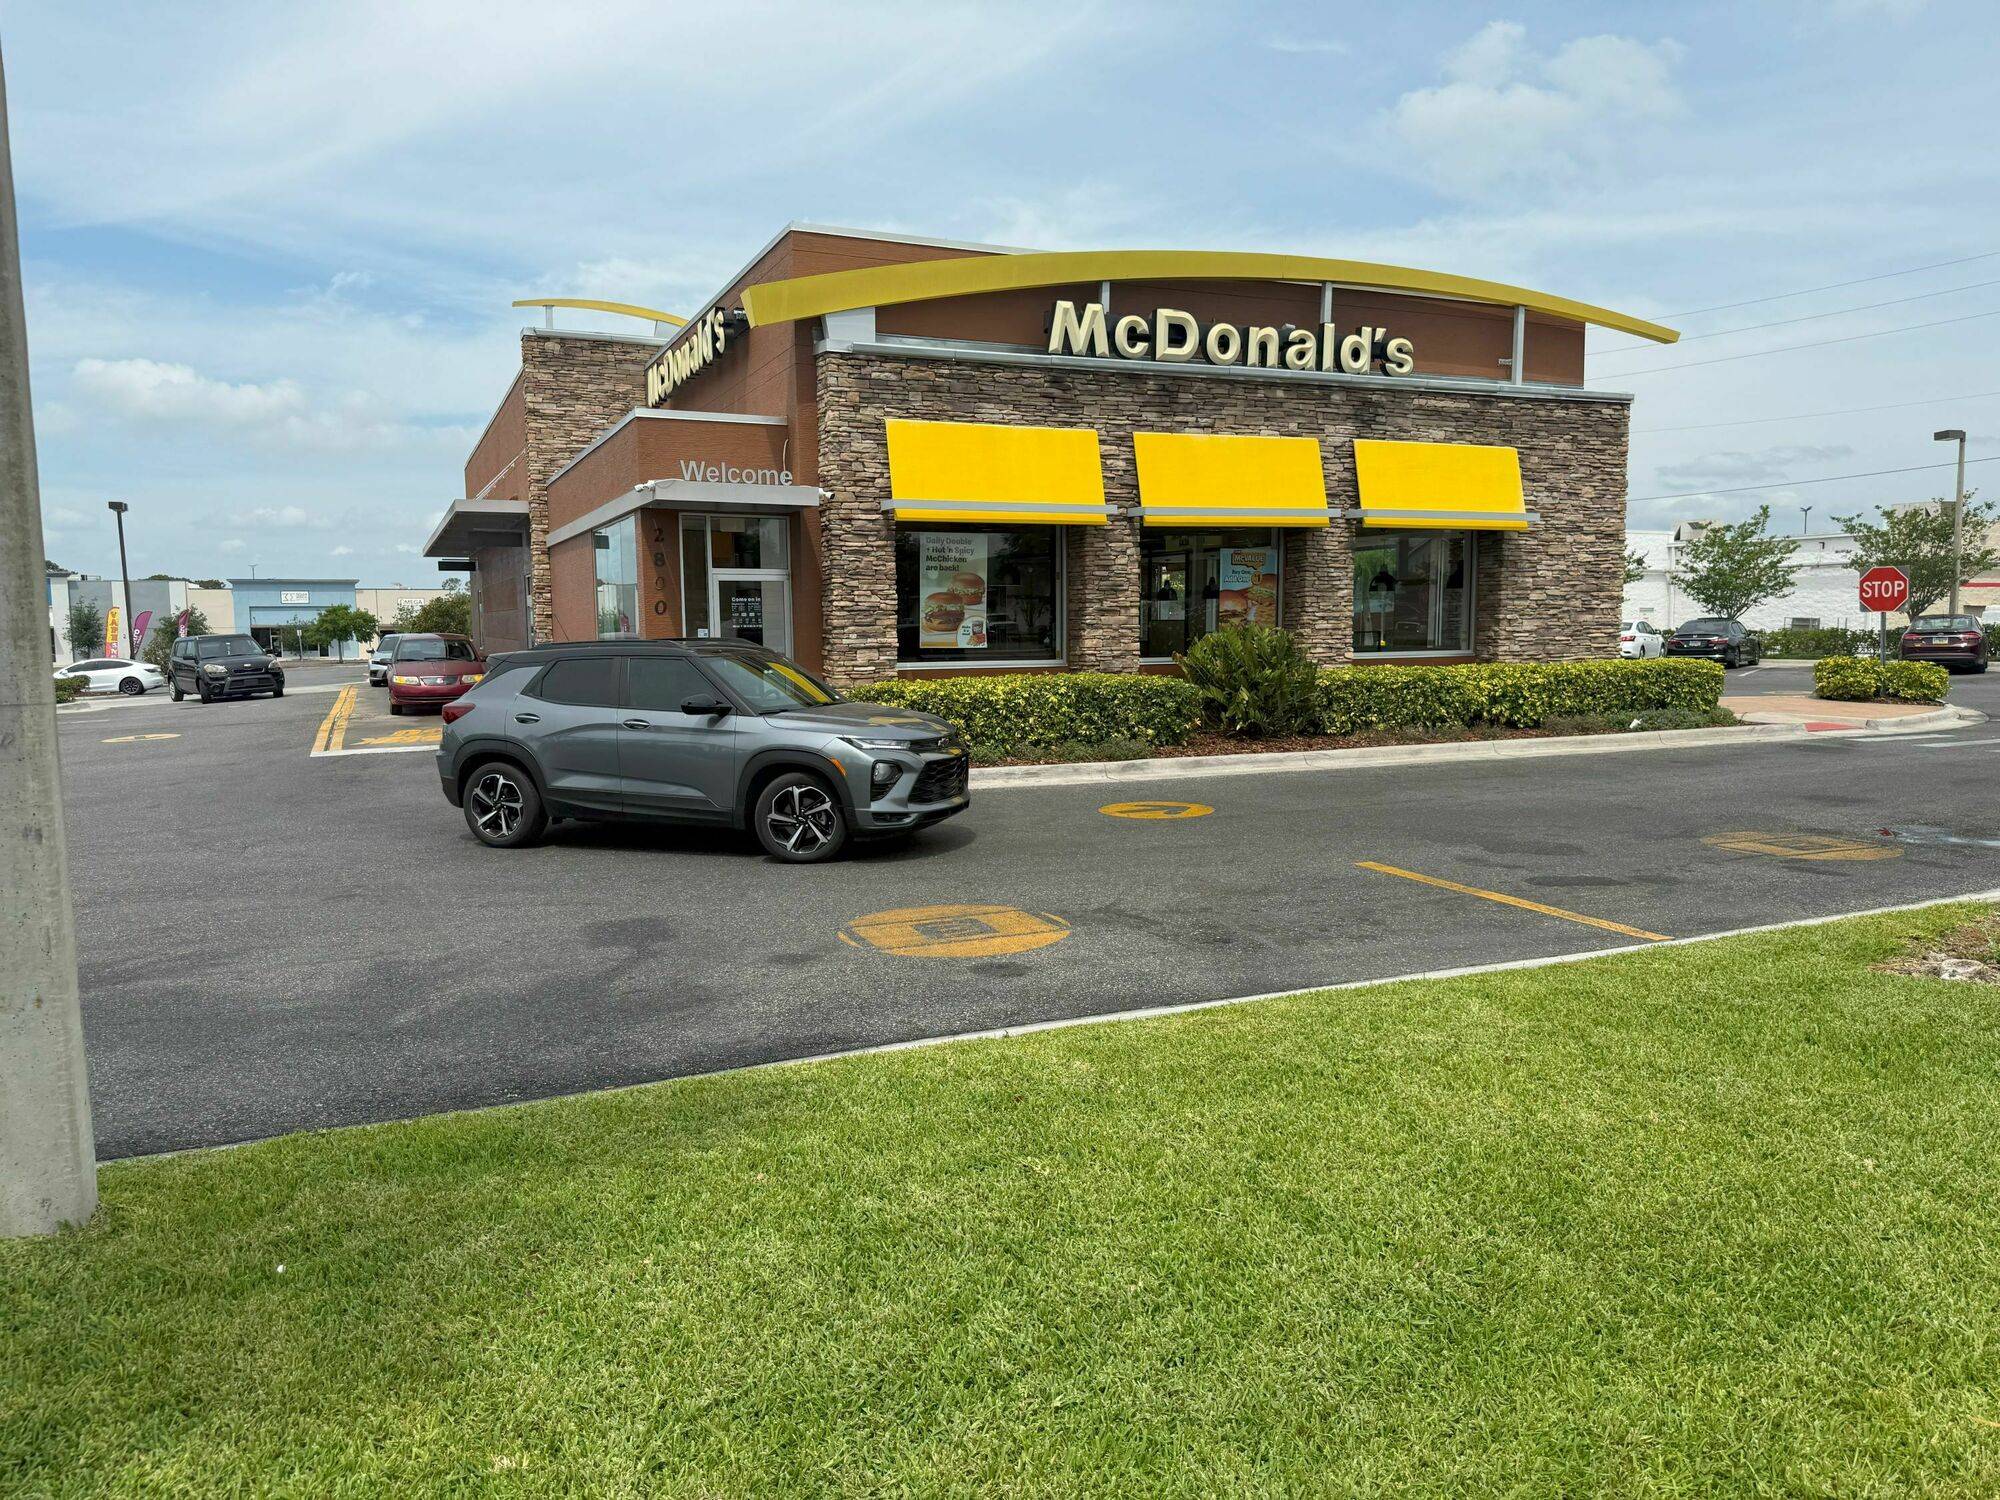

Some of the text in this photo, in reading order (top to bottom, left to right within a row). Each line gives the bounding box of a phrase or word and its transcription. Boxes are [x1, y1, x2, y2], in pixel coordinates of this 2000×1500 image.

[1048, 299, 1415, 377] McDonald's
[647, 307, 726, 408] McDonald's
[680, 460, 793, 486] Welcome
[925, 536, 973, 546] Daily Double
[925, 554, 967, 563] McChicken
[955, 546, 975, 556] Spicy
[653, 528, 668, 615] 2800
[939, 563, 960, 571] back!
[1861, 580, 1905, 598] STOP
